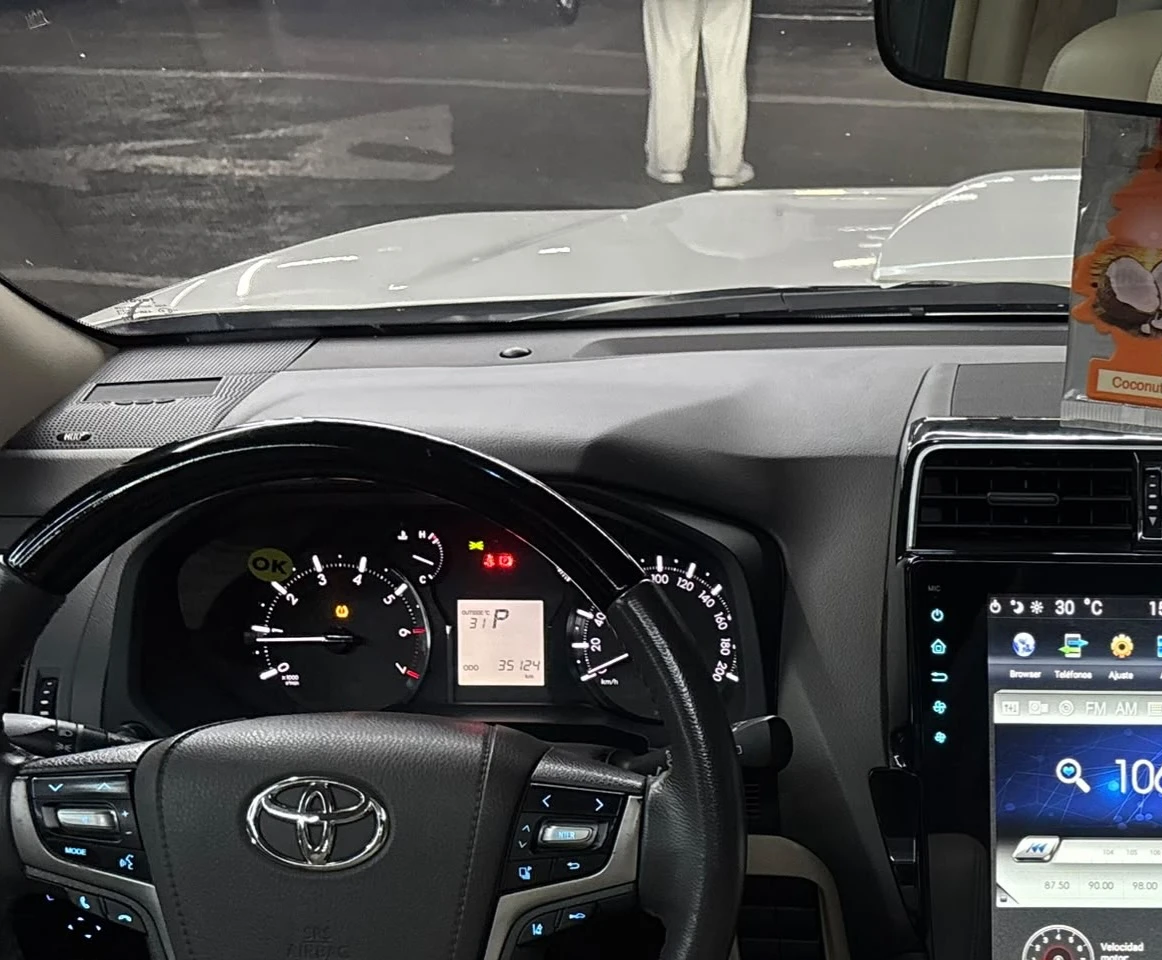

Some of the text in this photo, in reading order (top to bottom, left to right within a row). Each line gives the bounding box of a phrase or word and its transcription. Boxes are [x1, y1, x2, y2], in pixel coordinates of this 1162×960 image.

[252, 556, 287, 575] OK
[317, 573, 327, 586] 3
[352, 573, 363, 586] 4
[651, 573, 669, 585] 100
[676, 577, 695, 592] 120
[286, 592, 299, 606] 2
[383, 593, 396, 605] 5
[698, 590, 716, 609] 140
[1055, 600, 1075, 615] 30
[469, 617, 487, 629] 31
[492, 609, 509, 629] P
[593, 611, 607, 628] 40
[713, 611, 729, 631] 160
[398, 627, 411, 637] 6
[590, 637, 602, 652] 20
[720, 638, 731, 656] 180
[277, 662, 290, 673] 0
[395, 662, 407, 674] 7
[712, 660, 728, 682] 200
[1009, 670, 1042, 680] Browser
[1054, 669, 1093, 681] Teléfonos
[1108, 671, 1134, 682] Ajuste
[1086, 702, 1138, 715] FM AM
[64, 846, 88, 856] MODE
[1044, 881, 1070, 891] 87.50
[1088, 881, 1114, 891] 90.00
[1132, 881, 1158, 891] 98.00
[1100, 942, 1144, 952] Velocidad
